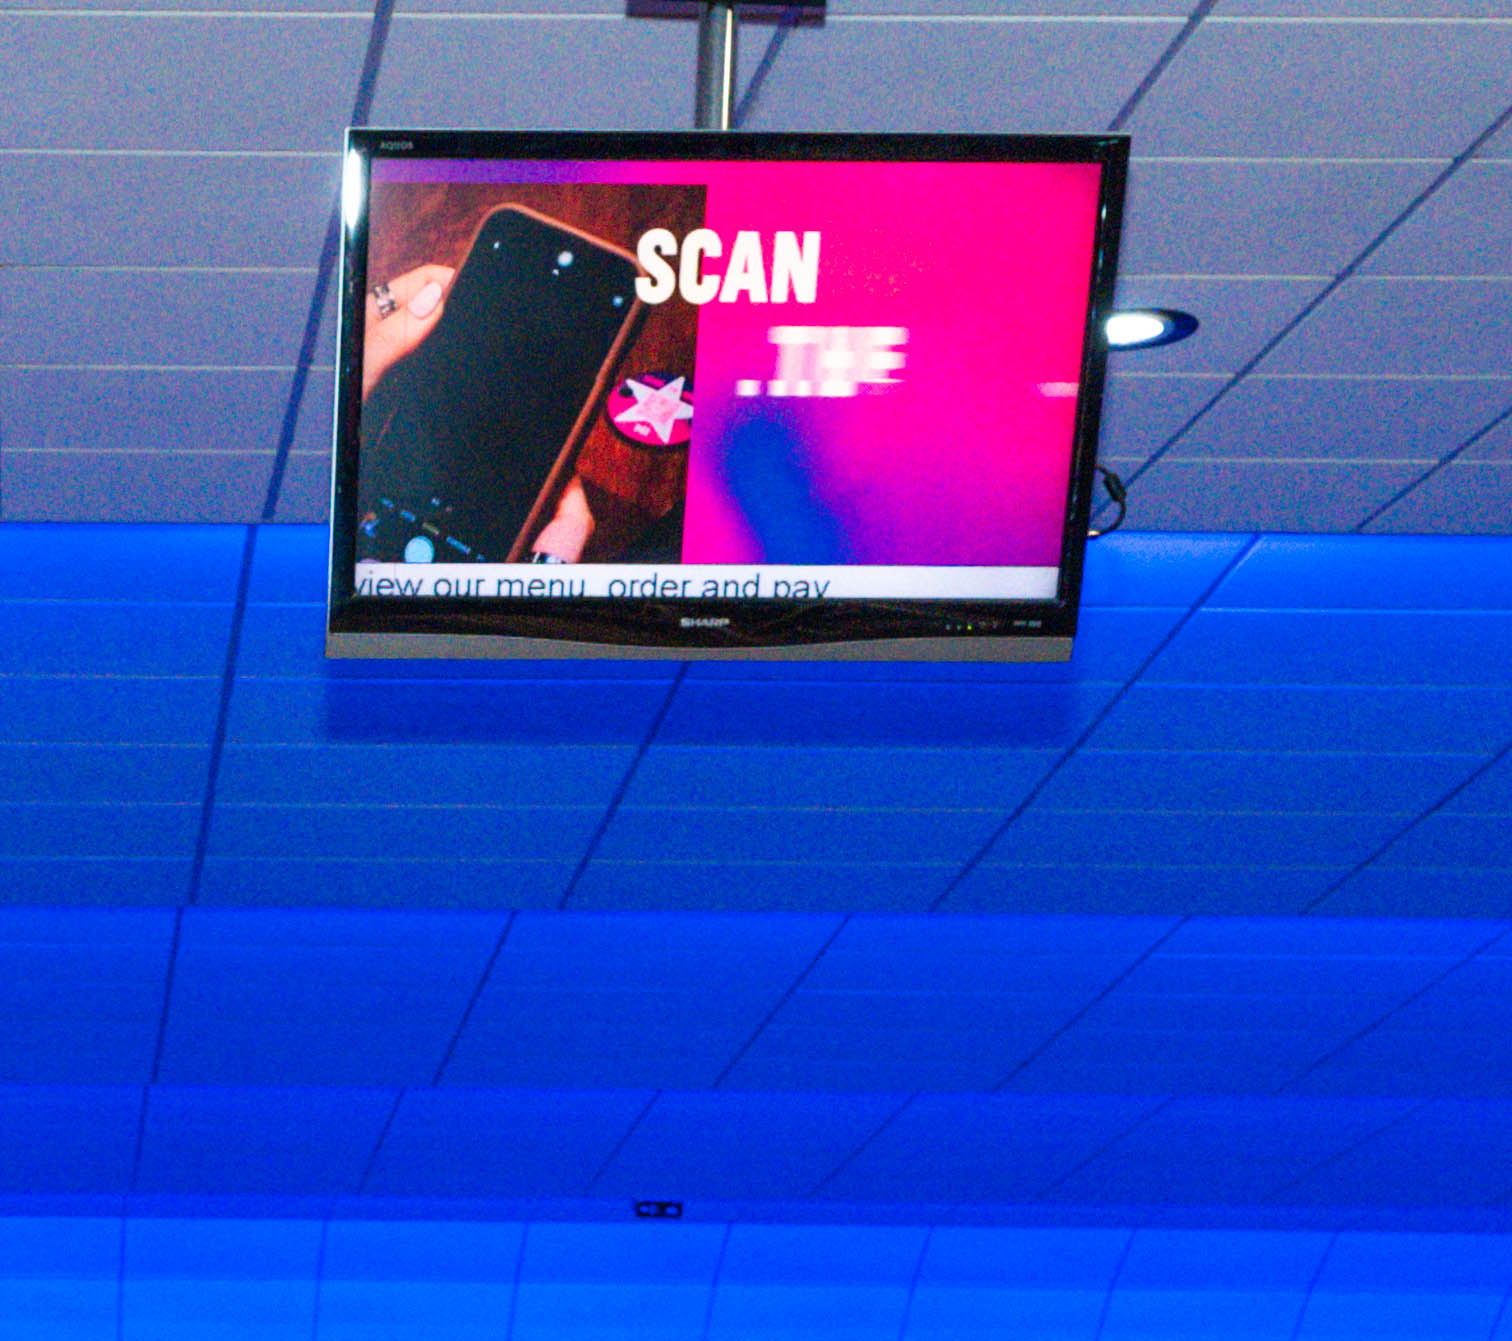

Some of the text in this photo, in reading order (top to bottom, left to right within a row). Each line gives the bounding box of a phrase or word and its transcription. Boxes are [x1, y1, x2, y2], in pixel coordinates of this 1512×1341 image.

[635, 227, 823, 306] SCAN
[434, 576, 488, 598] our
[608, 572, 692, 599] order
[703, 573, 765, 599] and
[679, 616, 730, 628] SHARP
